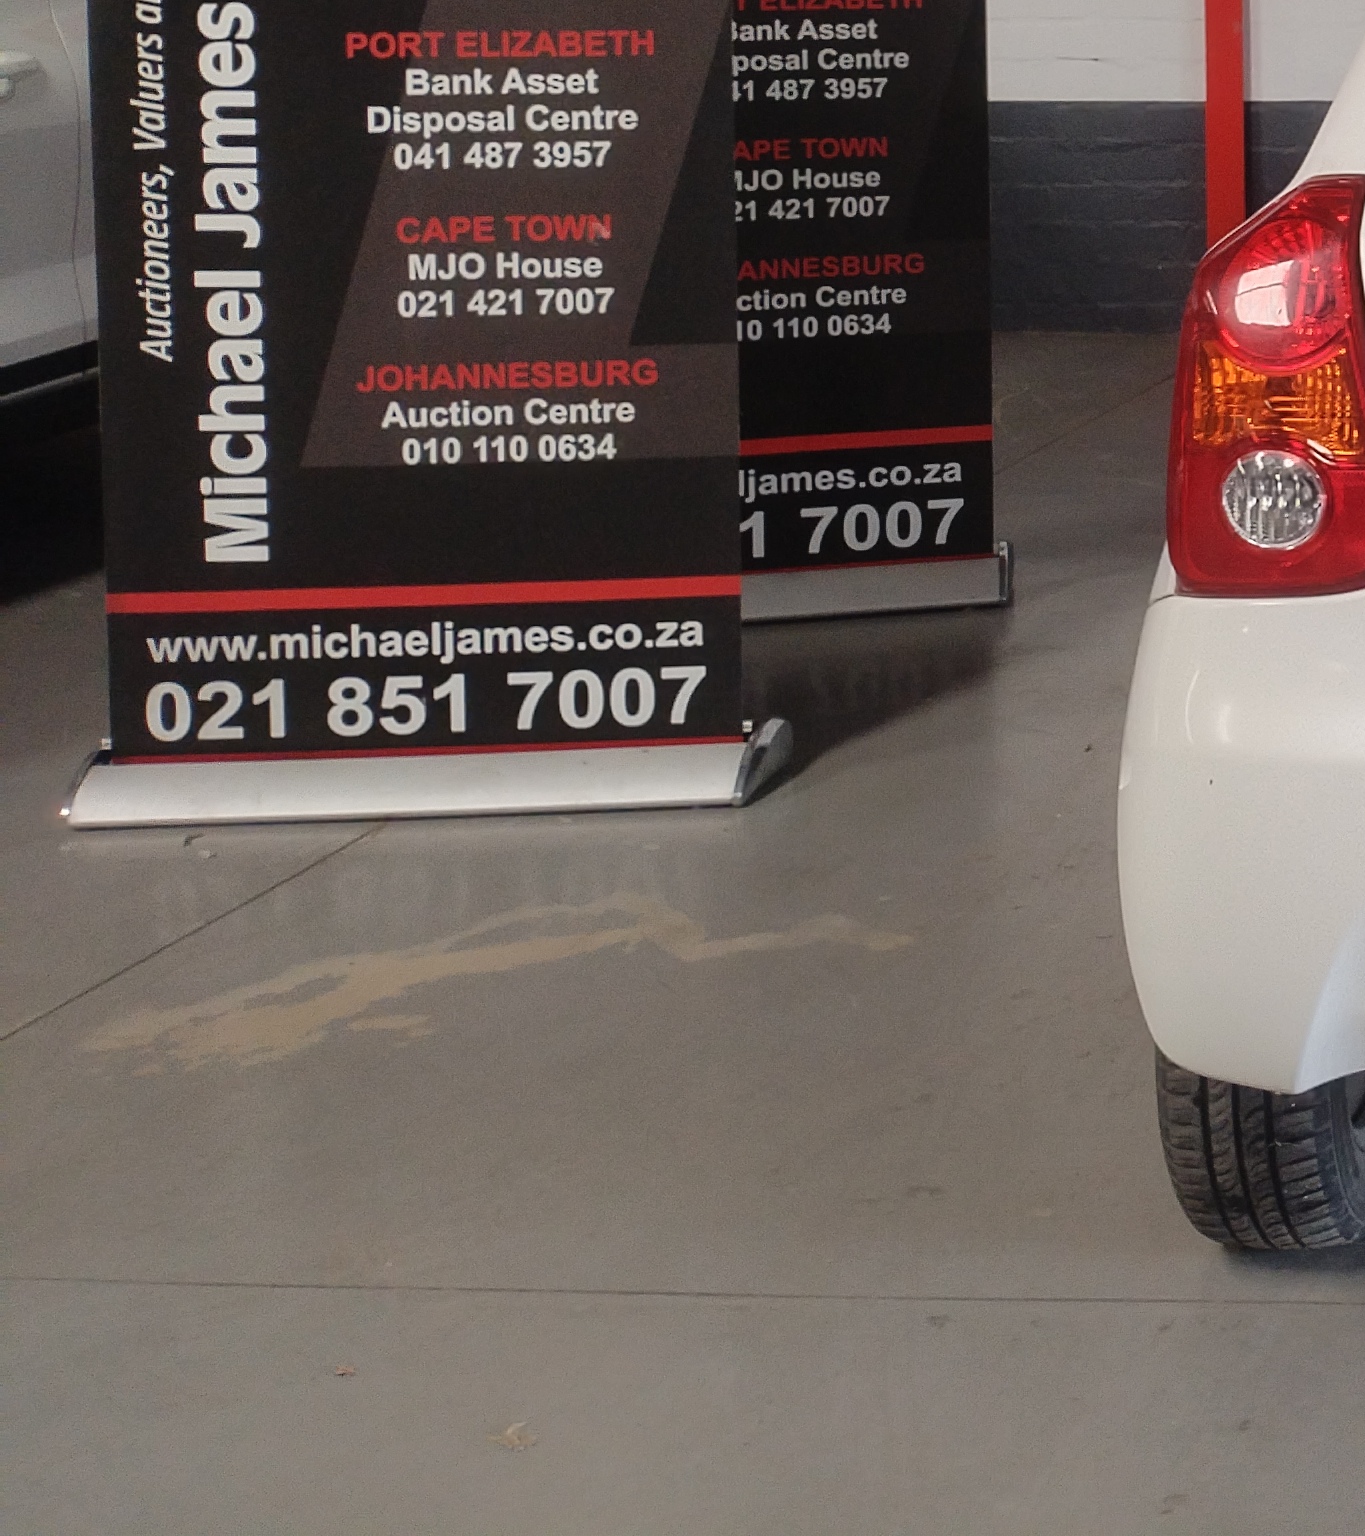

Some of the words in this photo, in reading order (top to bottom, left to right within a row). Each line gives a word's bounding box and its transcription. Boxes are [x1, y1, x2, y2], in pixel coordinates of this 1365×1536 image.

[345, 31, 444, 59] PORT
[455, 30, 654, 58] ELIZABETH
[731, 19, 790, 41] ank
[797, 19, 878, 40] Asset
[818, 48, 909, 69] Centre
[130, 32, 167, 150] Valuers
[406, 68, 493, 95] Bank
[501, 68, 599, 94] Asset
[766, 79, 815, 100] 487
[824, 77, 888, 99] 3957
[195, 2, 260, 248] James
[368, 105, 515, 139] Disposal
[526, 104, 638, 131] Centre
[394, 142, 450, 170] 041
[464, 142, 523, 169] 487
[534, 141, 611, 168] 3957
[734, 138, 790, 160] APE
[801, 137, 888, 159] TOWN
[793, 168, 880, 189] House
[768, 198, 814, 219] 421
[826, 196, 890, 217] 7007
[396, 216, 495, 244] CAPE
[505, 214, 611, 242] TOWN
[136, 165, 175, 362] Auctioneers,
[408, 252, 486, 280] MJO
[496, 252, 602, 278] House
[737, 253, 924, 280] ANNESBURG
[398, 290, 453, 318] 021
[467, 289, 522, 316] 421
[536, 288, 614, 315] 7007
[736, 289, 806, 311] ction
[816, 286, 906, 307] Centre
[773, 316, 818, 338] 110
[828, 313, 891, 336] 0634
[357, 358, 658, 392] JOHANNESBURG
[194, 271, 269, 562] Michael
[382, 400, 513, 428] Auction
[524, 398, 635, 425] Centre
[402, 437, 461, 465] 010
[473, 435, 528, 462] 110
[538, 433, 617, 461] 0634
[800, 498, 964, 554] 7007
[146, 621, 703, 664] www.michaeljames.co.za
[146, 679, 285, 741] 021
[328, 674, 466, 736] 851
[507, 666, 706, 730] 7007
